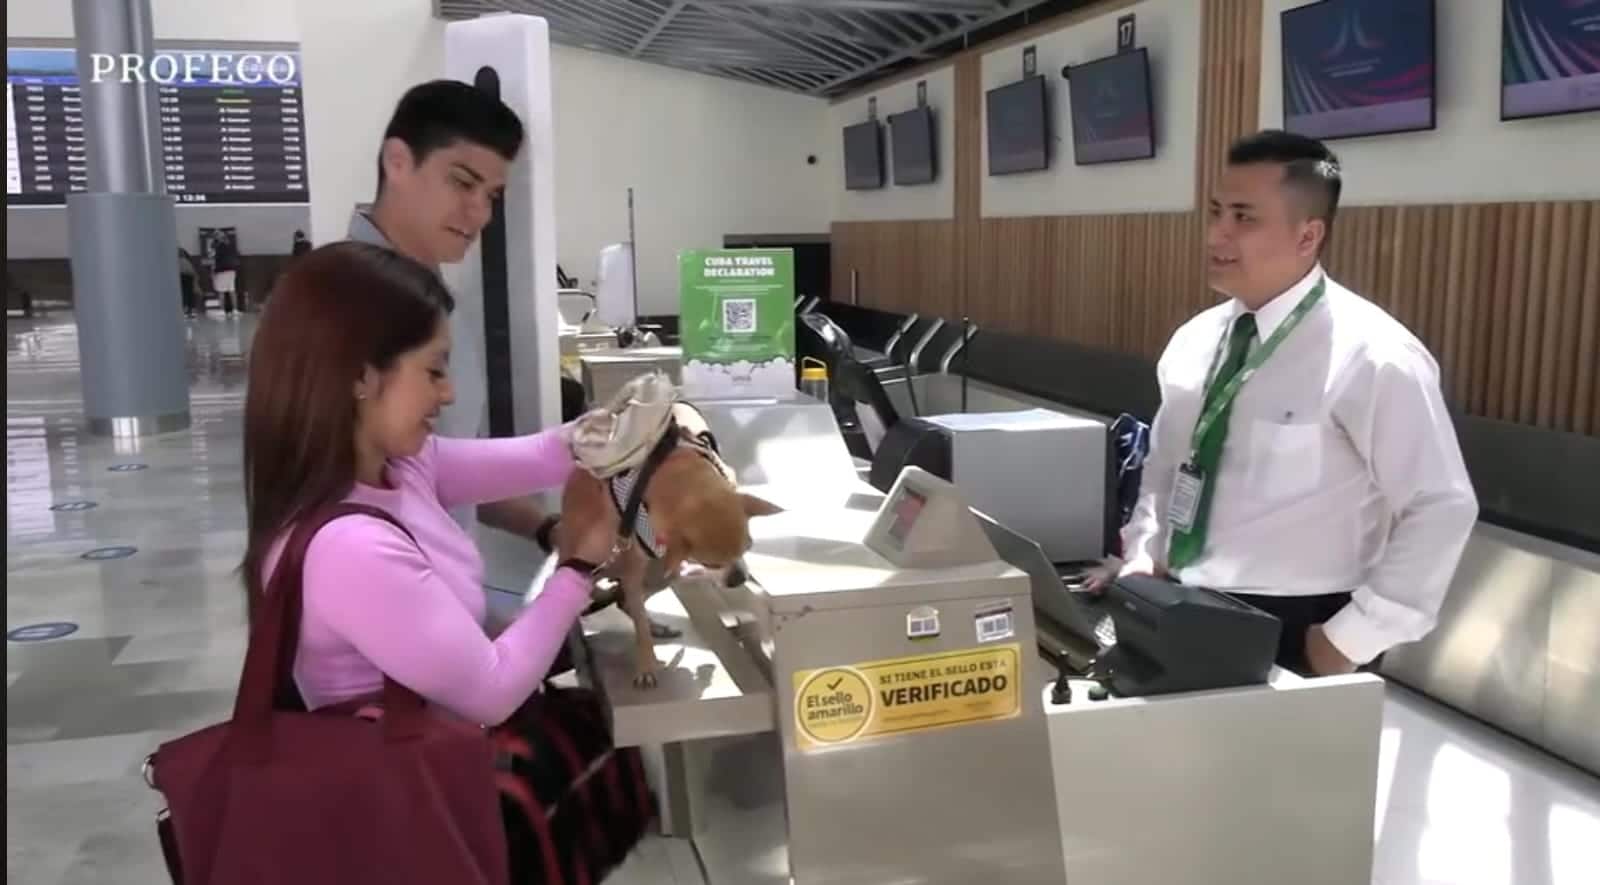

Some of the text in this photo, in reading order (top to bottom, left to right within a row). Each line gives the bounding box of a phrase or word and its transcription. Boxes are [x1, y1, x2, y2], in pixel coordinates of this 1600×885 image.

[1120, 21, 1133, 47] 17
[705, 256, 774, 266] CUBA TRAVEL
[704, 267, 775, 277] DECLARATION
[880, 674, 891, 685] SI
[895, 669, 926, 682] TIENE
[930, 668, 942, 678] EL
[945, 662, 977, 675] SELLO
[807, 691, 853, 708] El sello
[880, 674, 1008, 708] VERIFICADO
[807, 703, 864, 720] amarillo
